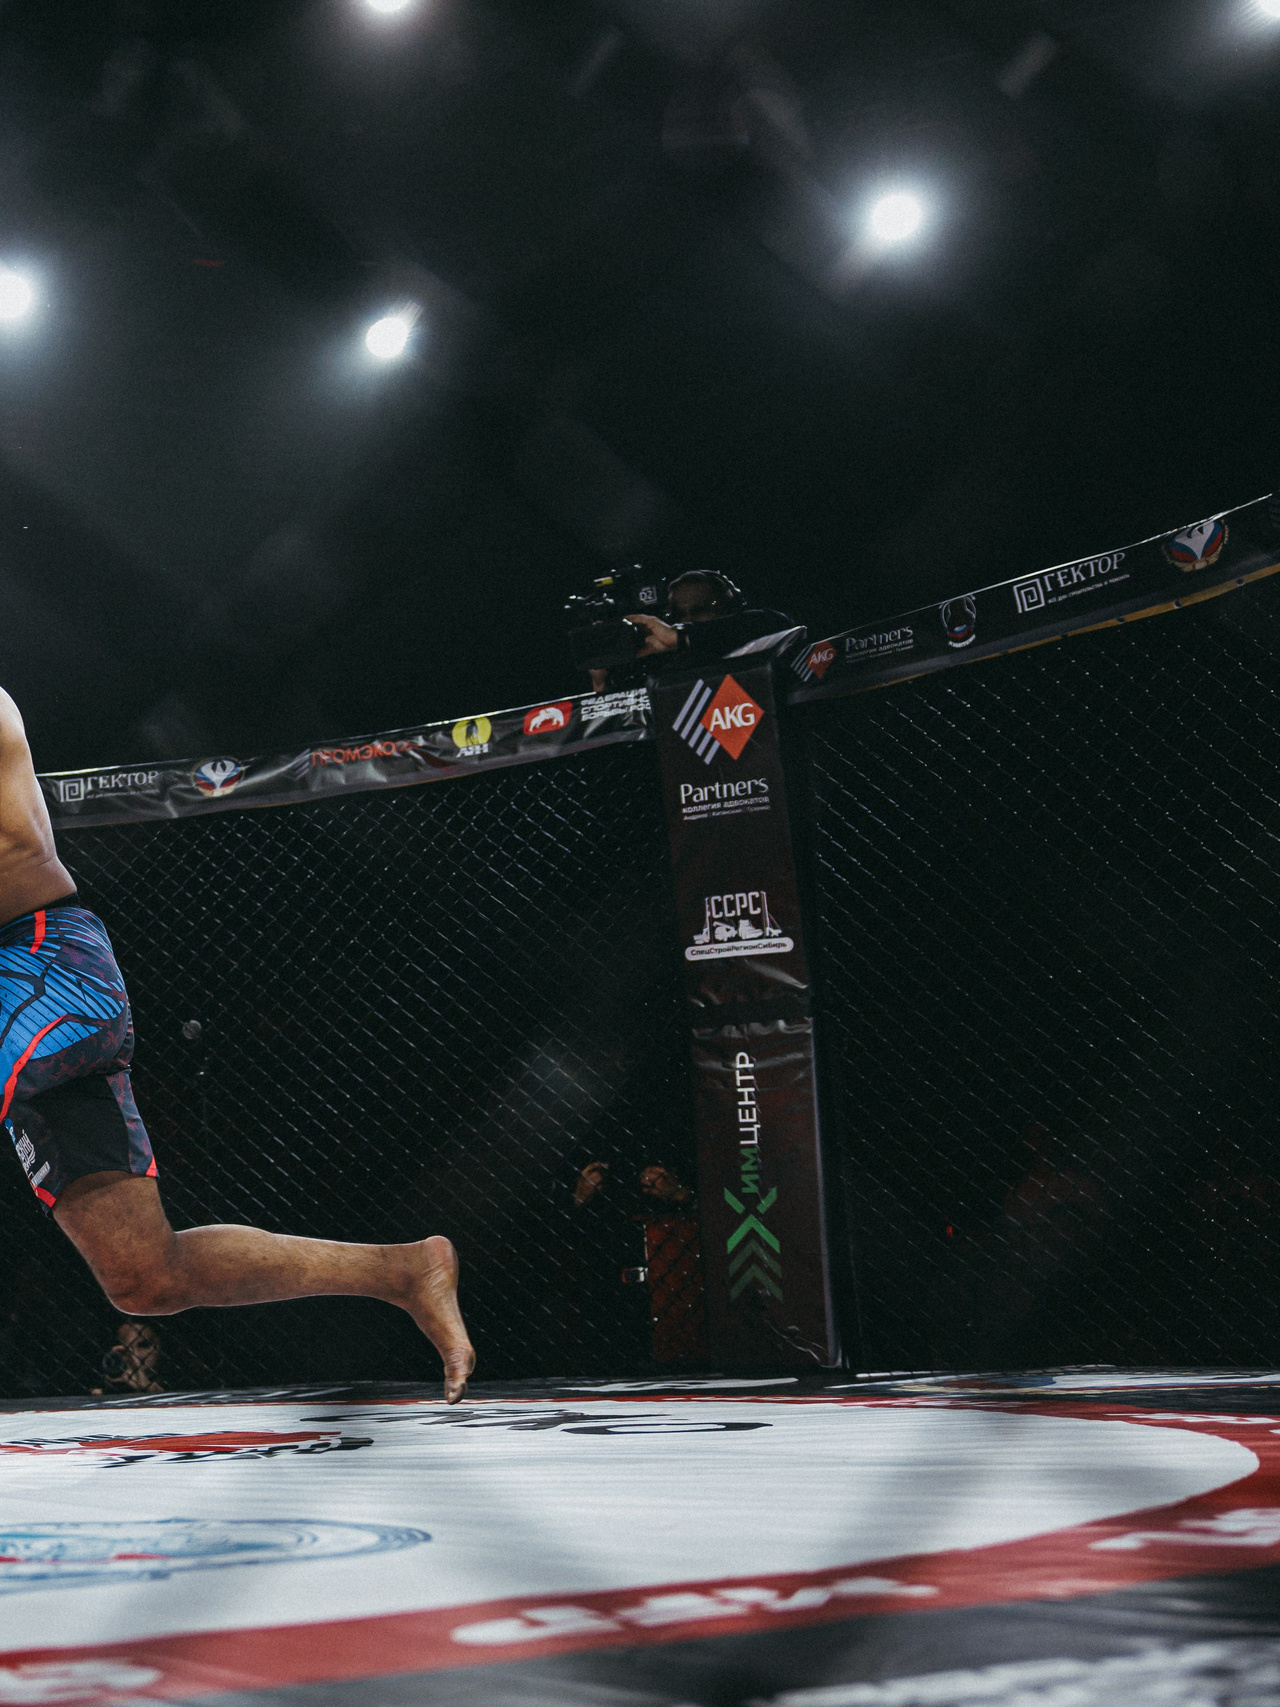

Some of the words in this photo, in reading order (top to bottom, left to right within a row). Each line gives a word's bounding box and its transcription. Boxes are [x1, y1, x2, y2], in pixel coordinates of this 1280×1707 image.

[1043, 552, 1126, 592] ГЕКТОР
[845, 625, 914, 652] Partners
[809, 648, 834, 665] AKG
[709, 702, 756, 732] AKG
[87, 769, 159, 791] ГЕКТОР
[680, 777, 769, 805] Partners
[690, 941, 787, 956] СпецСтройРегионСибирь
